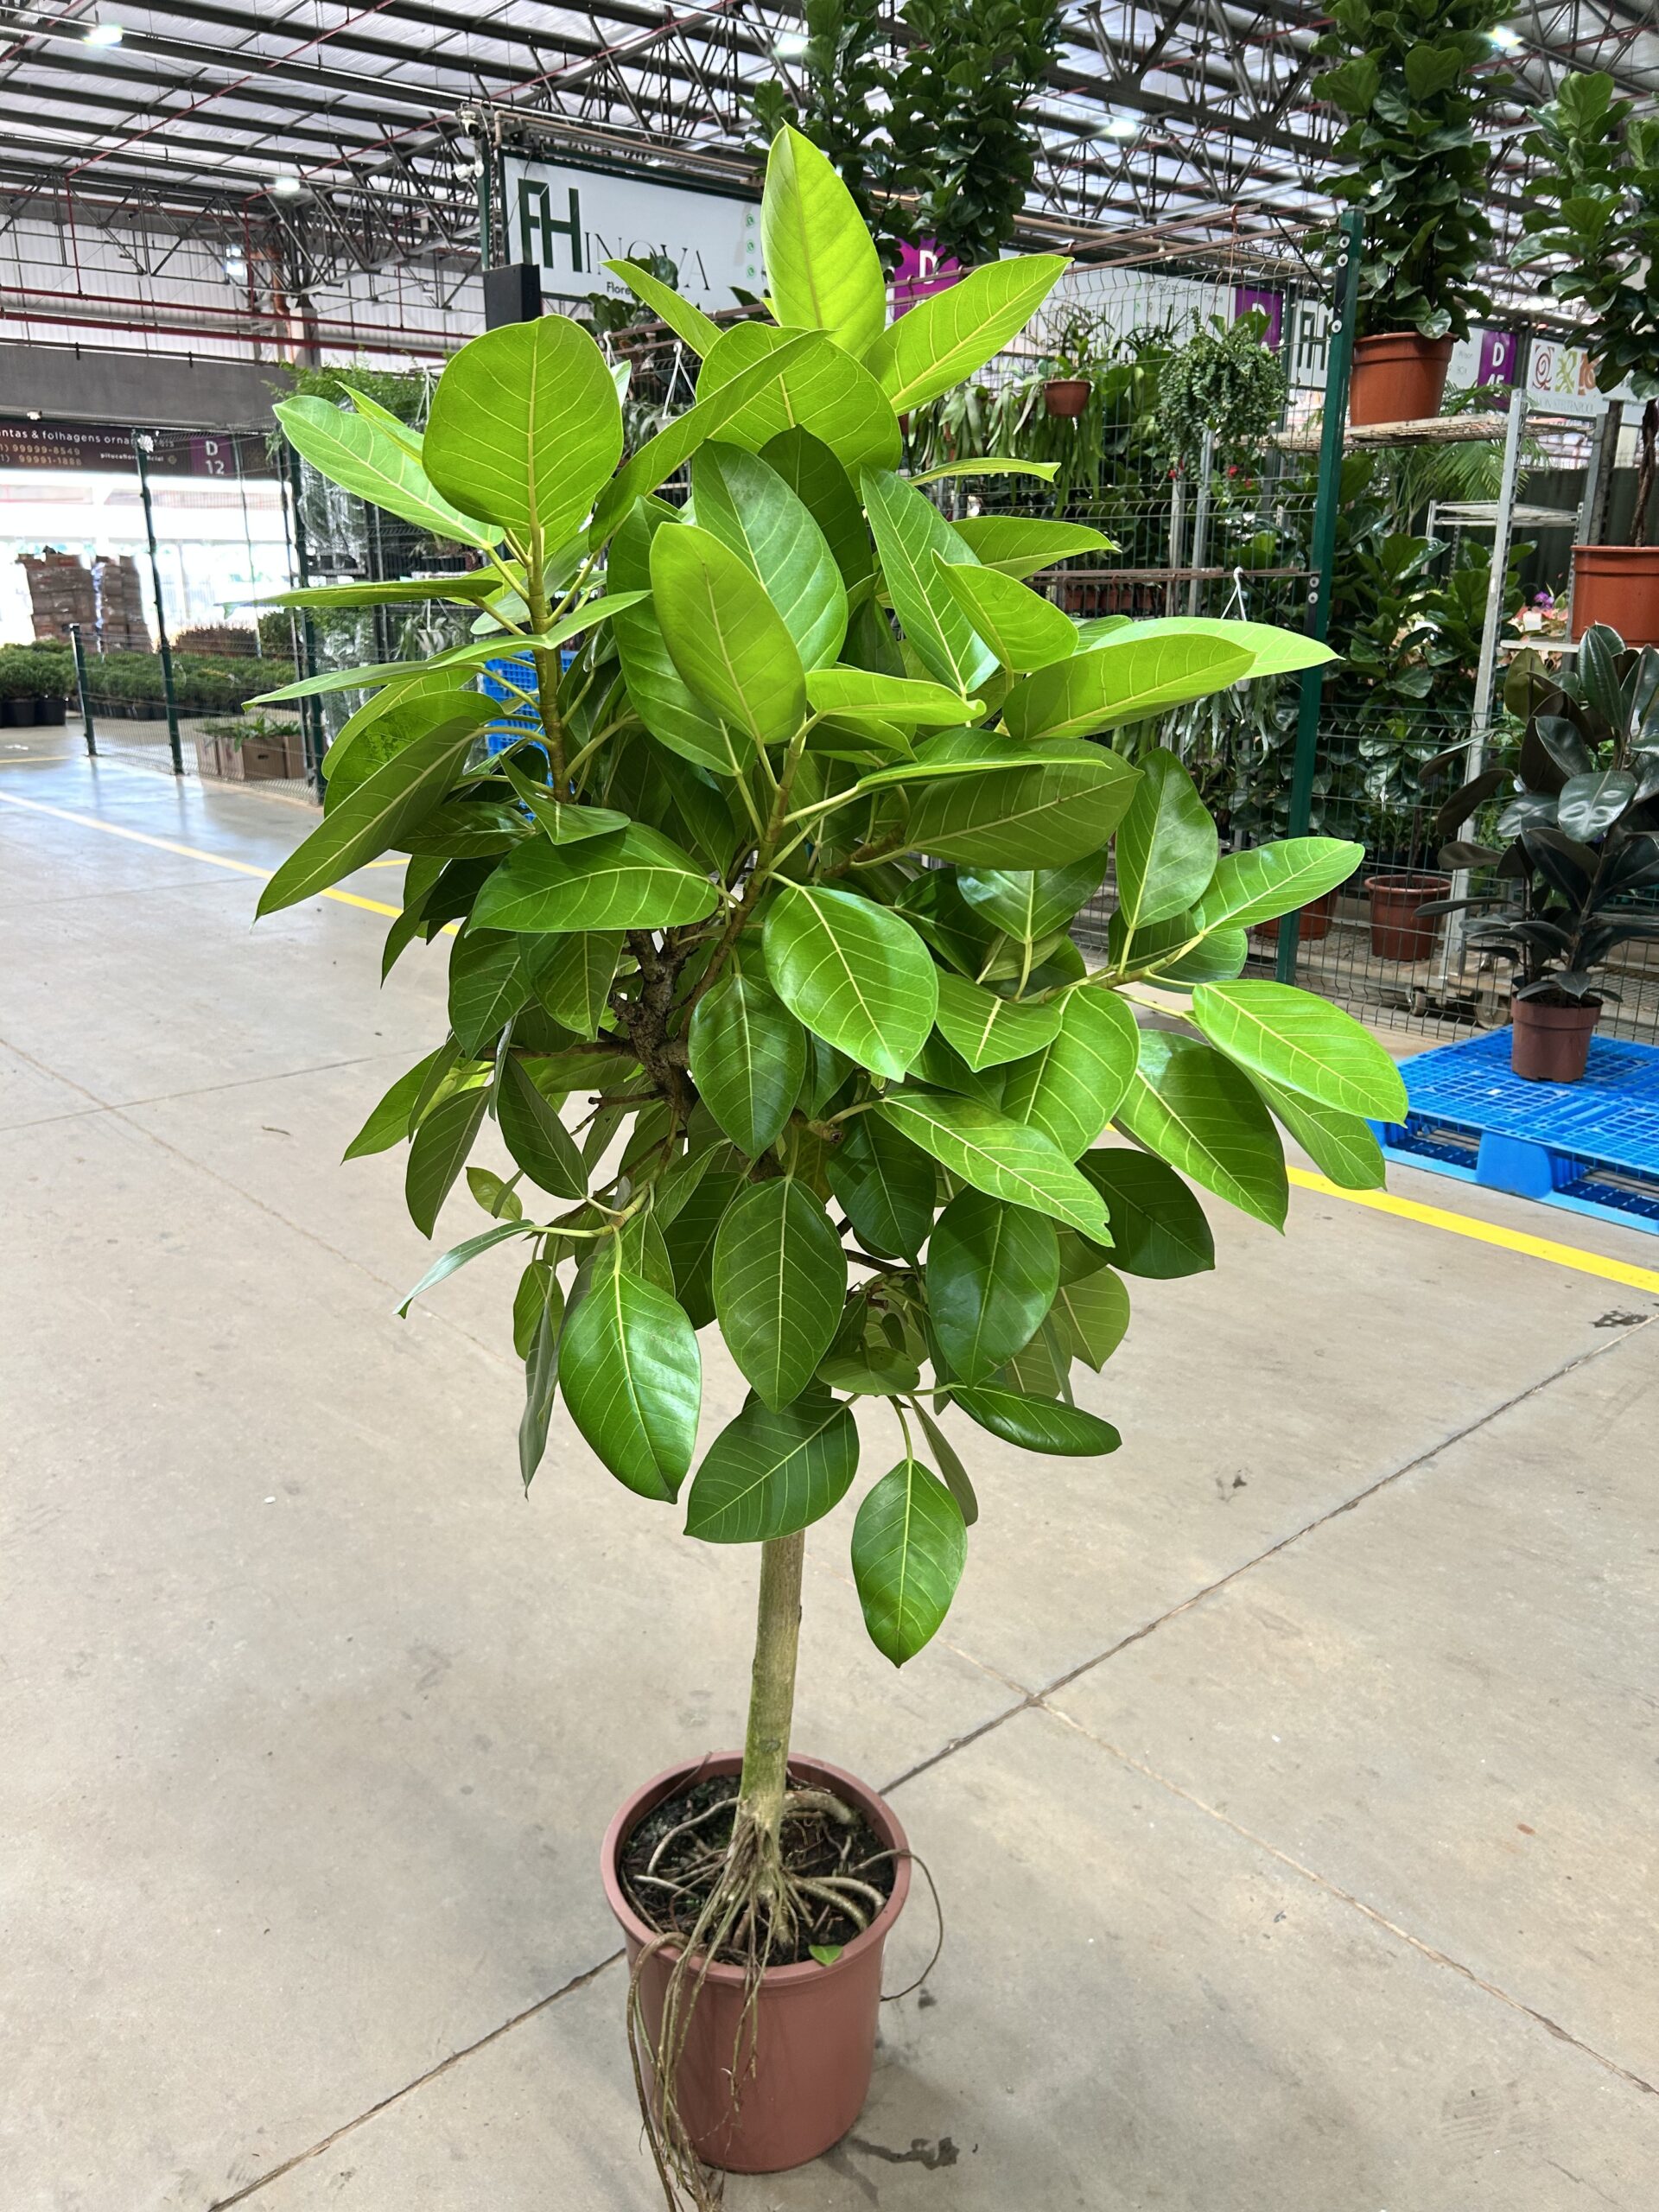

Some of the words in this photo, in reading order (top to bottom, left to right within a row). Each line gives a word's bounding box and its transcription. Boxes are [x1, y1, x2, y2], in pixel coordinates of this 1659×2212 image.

[1492, 341, 1505, 366] D
[0, 429, 29, 439] ntas
[31, 429, 40, 440] &
[42, 430, 101, 443] folhagens
[206, 441, 219, 456] D
[206, 459, 226, 475] 12
